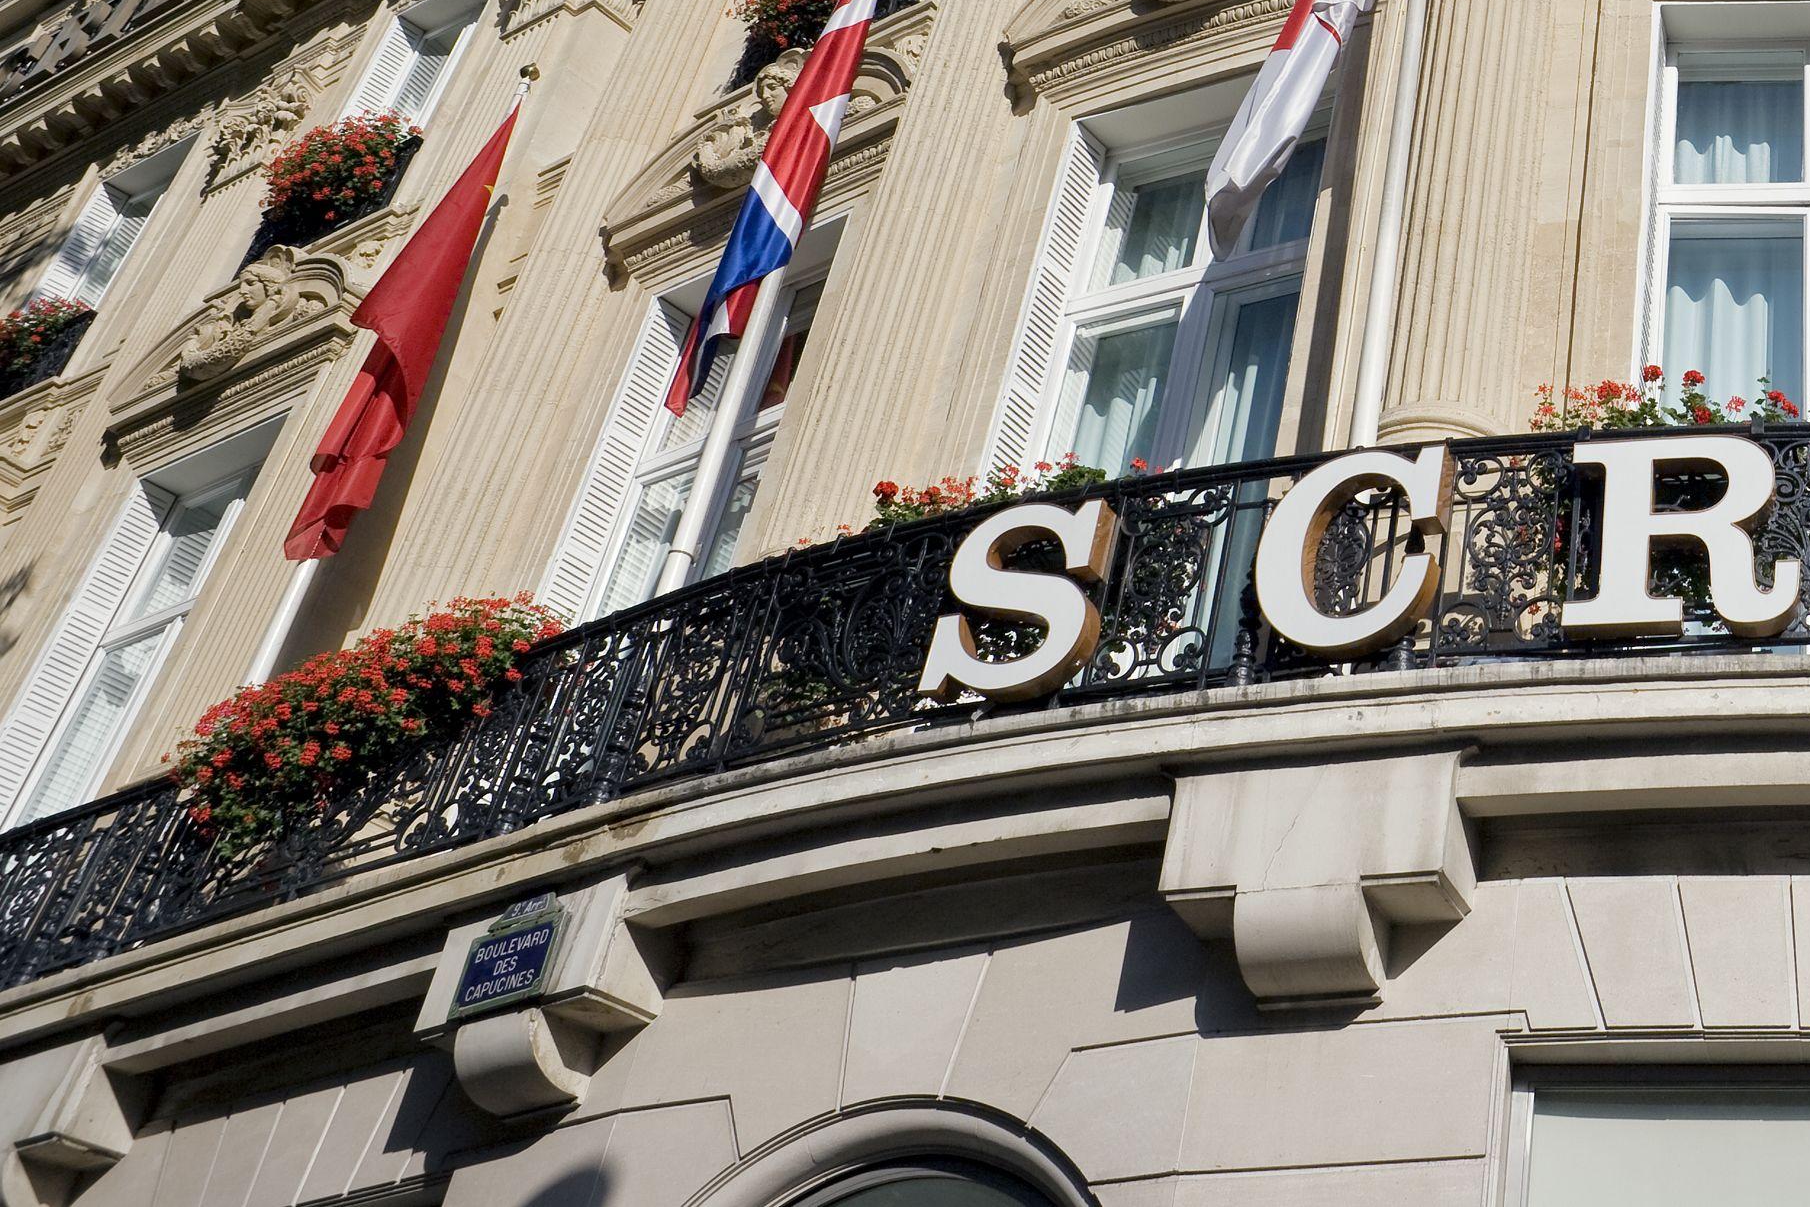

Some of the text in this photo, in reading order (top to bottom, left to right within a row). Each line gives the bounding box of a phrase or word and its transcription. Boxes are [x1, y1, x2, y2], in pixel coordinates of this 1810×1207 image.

[475, 928, 550, 964] BOULEVARD
[493, 955, 518, 976] DES
[464, 968, 535, 1002] CAPUCINES
